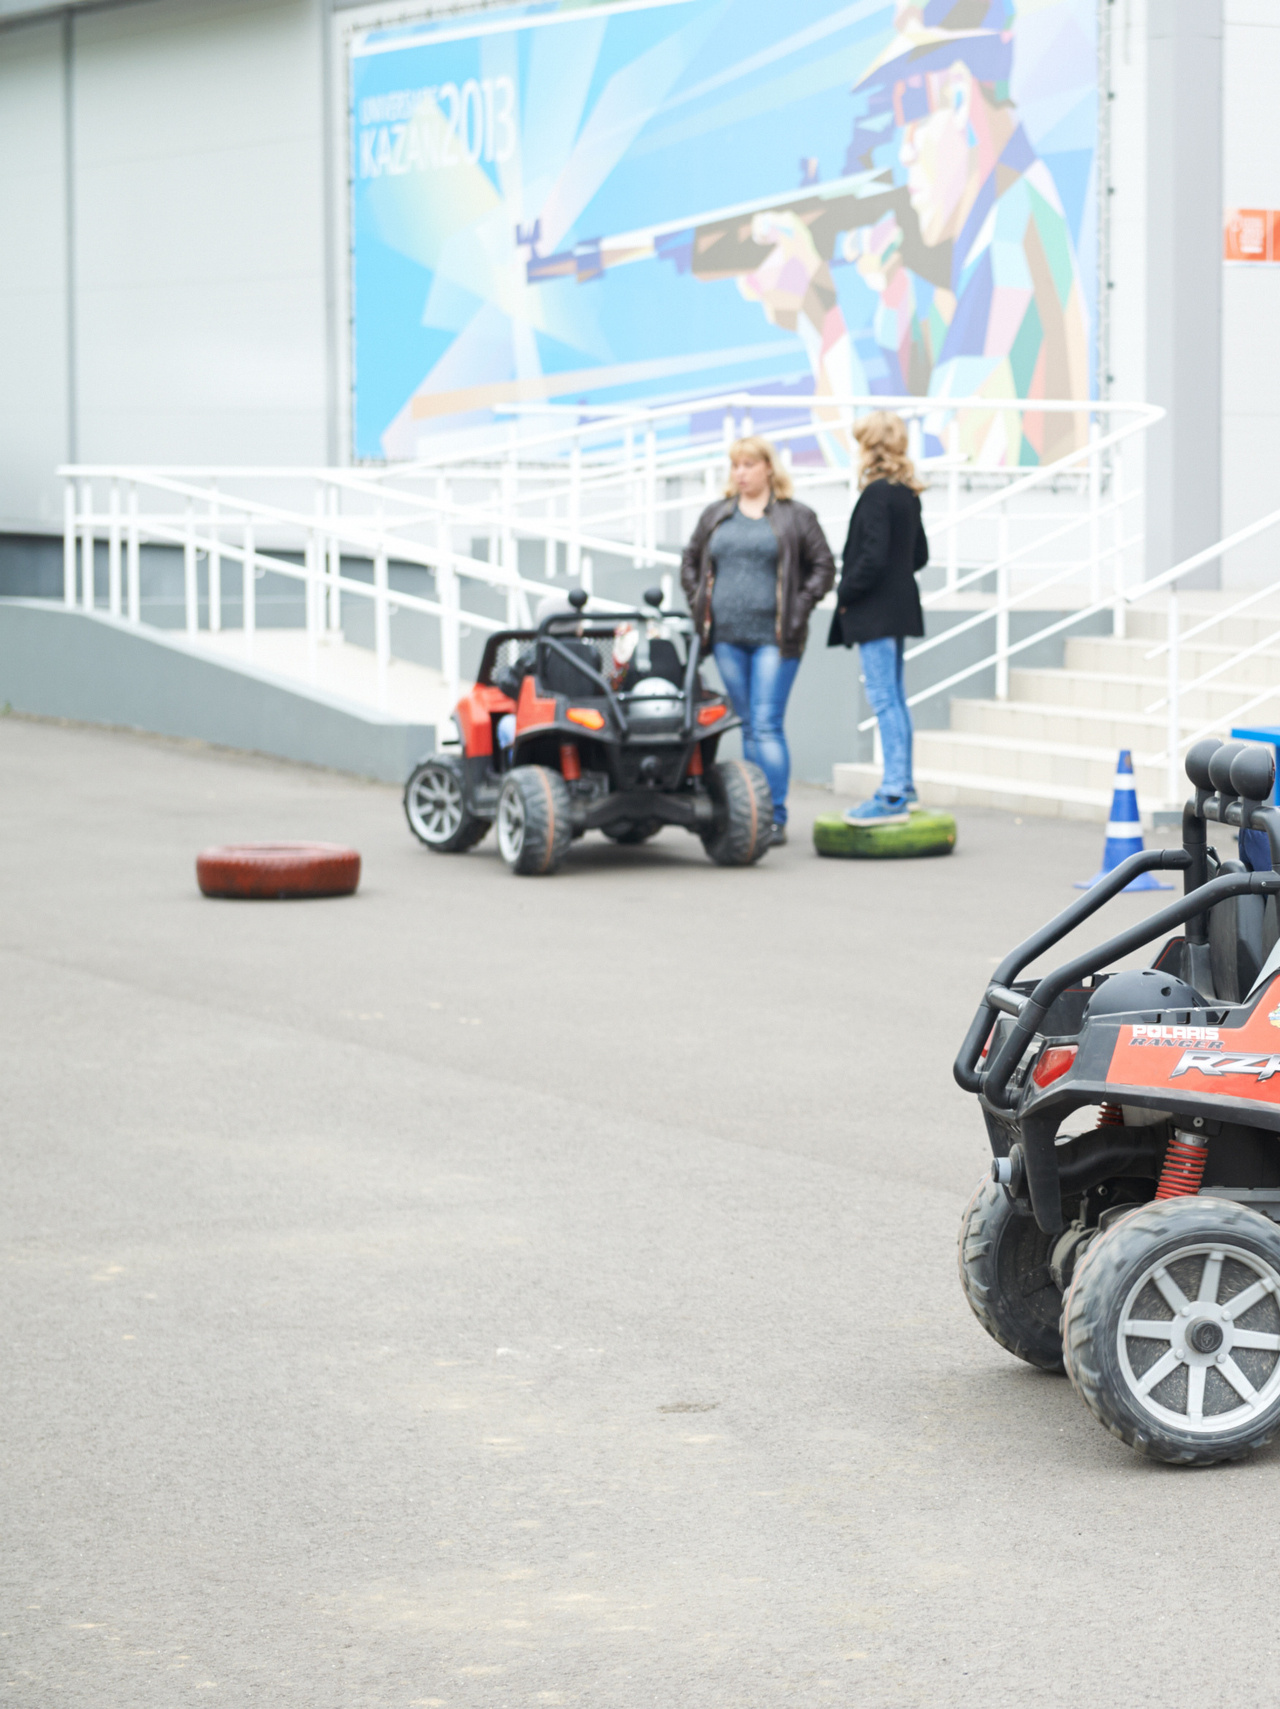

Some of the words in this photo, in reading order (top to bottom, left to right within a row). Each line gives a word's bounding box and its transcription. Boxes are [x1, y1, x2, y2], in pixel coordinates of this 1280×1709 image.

[360, 122, 440, 179] KAZAN
[438, 75, 517, 167] 2013
[1132, 1025, 1219, 1041] POLARIS
[1129, 1037, 1226, 1050] RANGER
